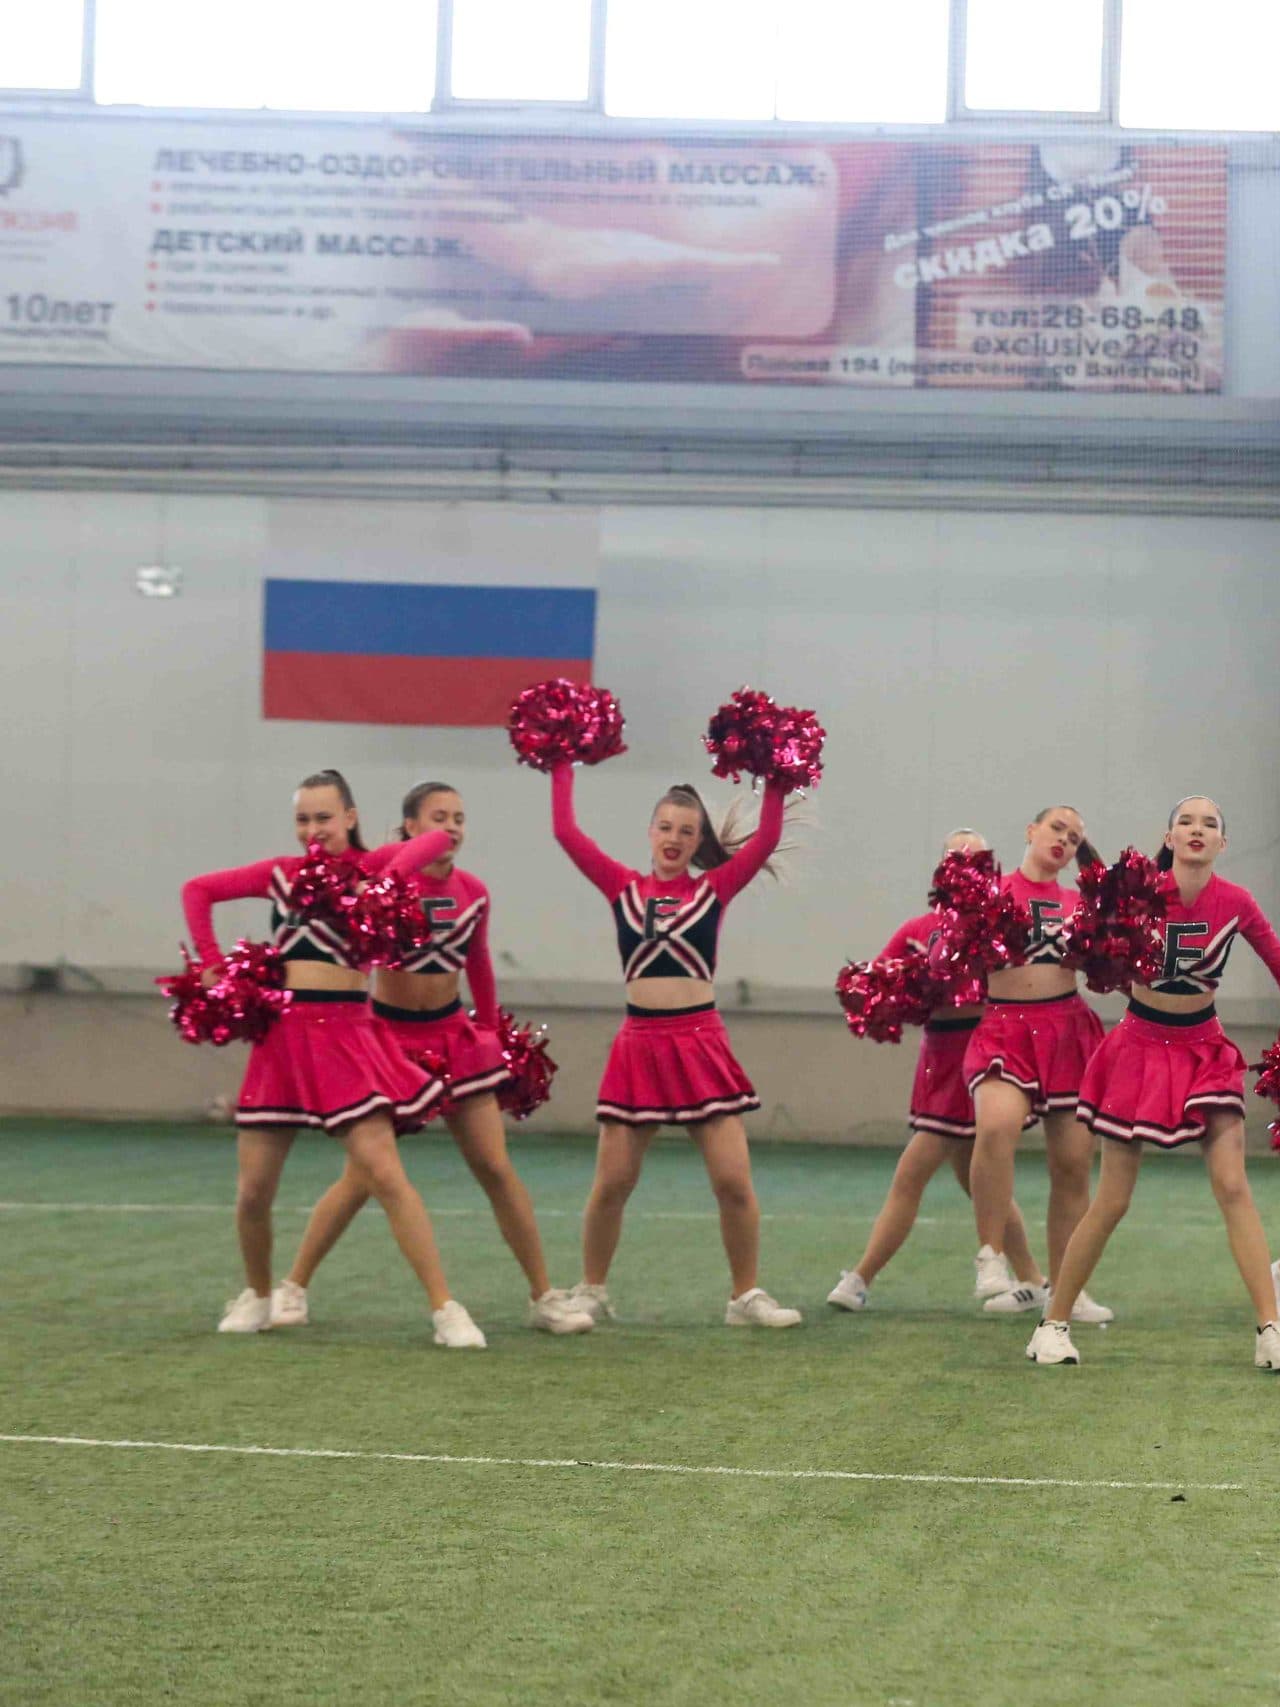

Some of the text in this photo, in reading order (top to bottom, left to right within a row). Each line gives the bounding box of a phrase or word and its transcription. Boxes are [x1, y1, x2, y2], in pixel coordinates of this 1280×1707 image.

[667, 160, 827, 187] МАССАЖ:
[1064, 183, 1168, 241] 20%
[151, 226, 305, 256] ДЕТСКИЙ
[6, 293, 115, 324] 10лет
[972, 333, 1199, 361] exclusive22.ru
[840, 357, 880, 373] 194
[643, 896, 683, 941] F
[1029, 898, 1064, 944] F
[1161, 922, 1209, 979] F
